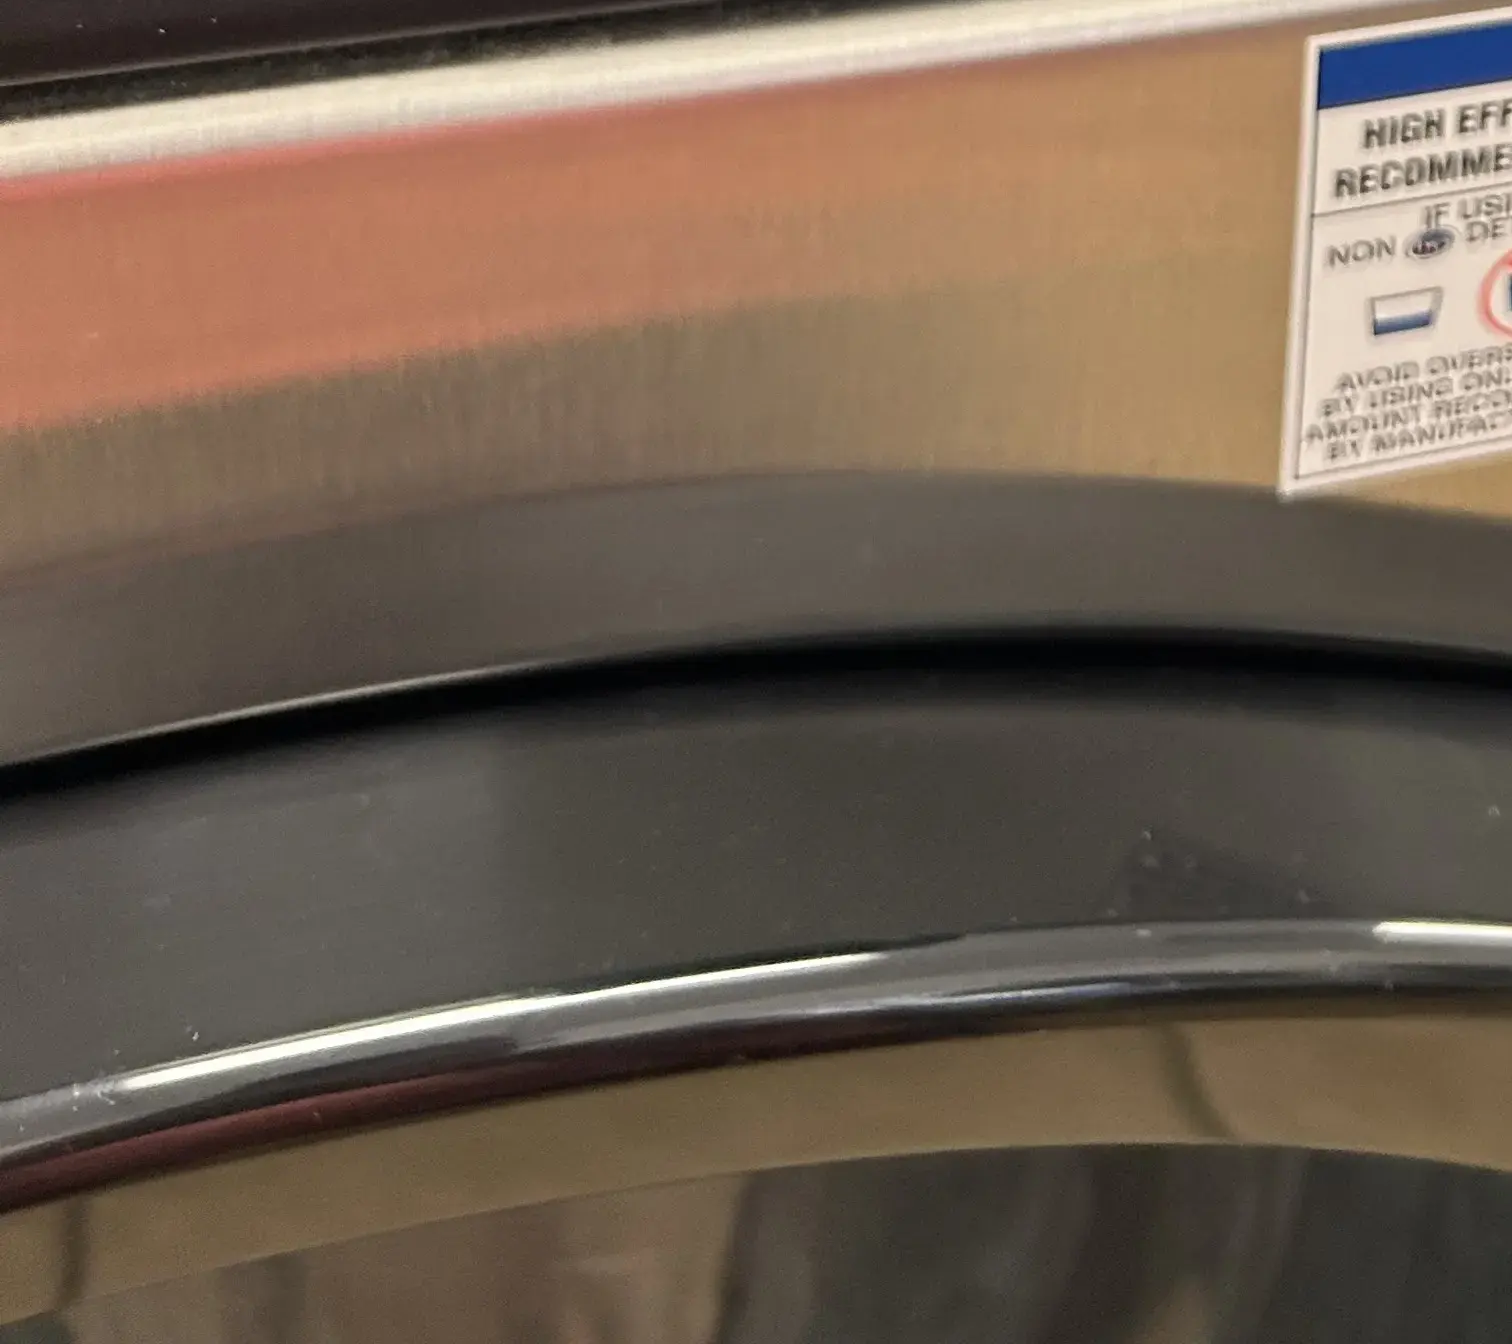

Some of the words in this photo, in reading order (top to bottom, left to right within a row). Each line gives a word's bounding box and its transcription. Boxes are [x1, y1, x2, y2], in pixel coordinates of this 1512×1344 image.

[1362, 108, 1445, 150] HIGH
[1422, 201, 1450, 228] IF
[1326, 234, 1397, 268] NON
